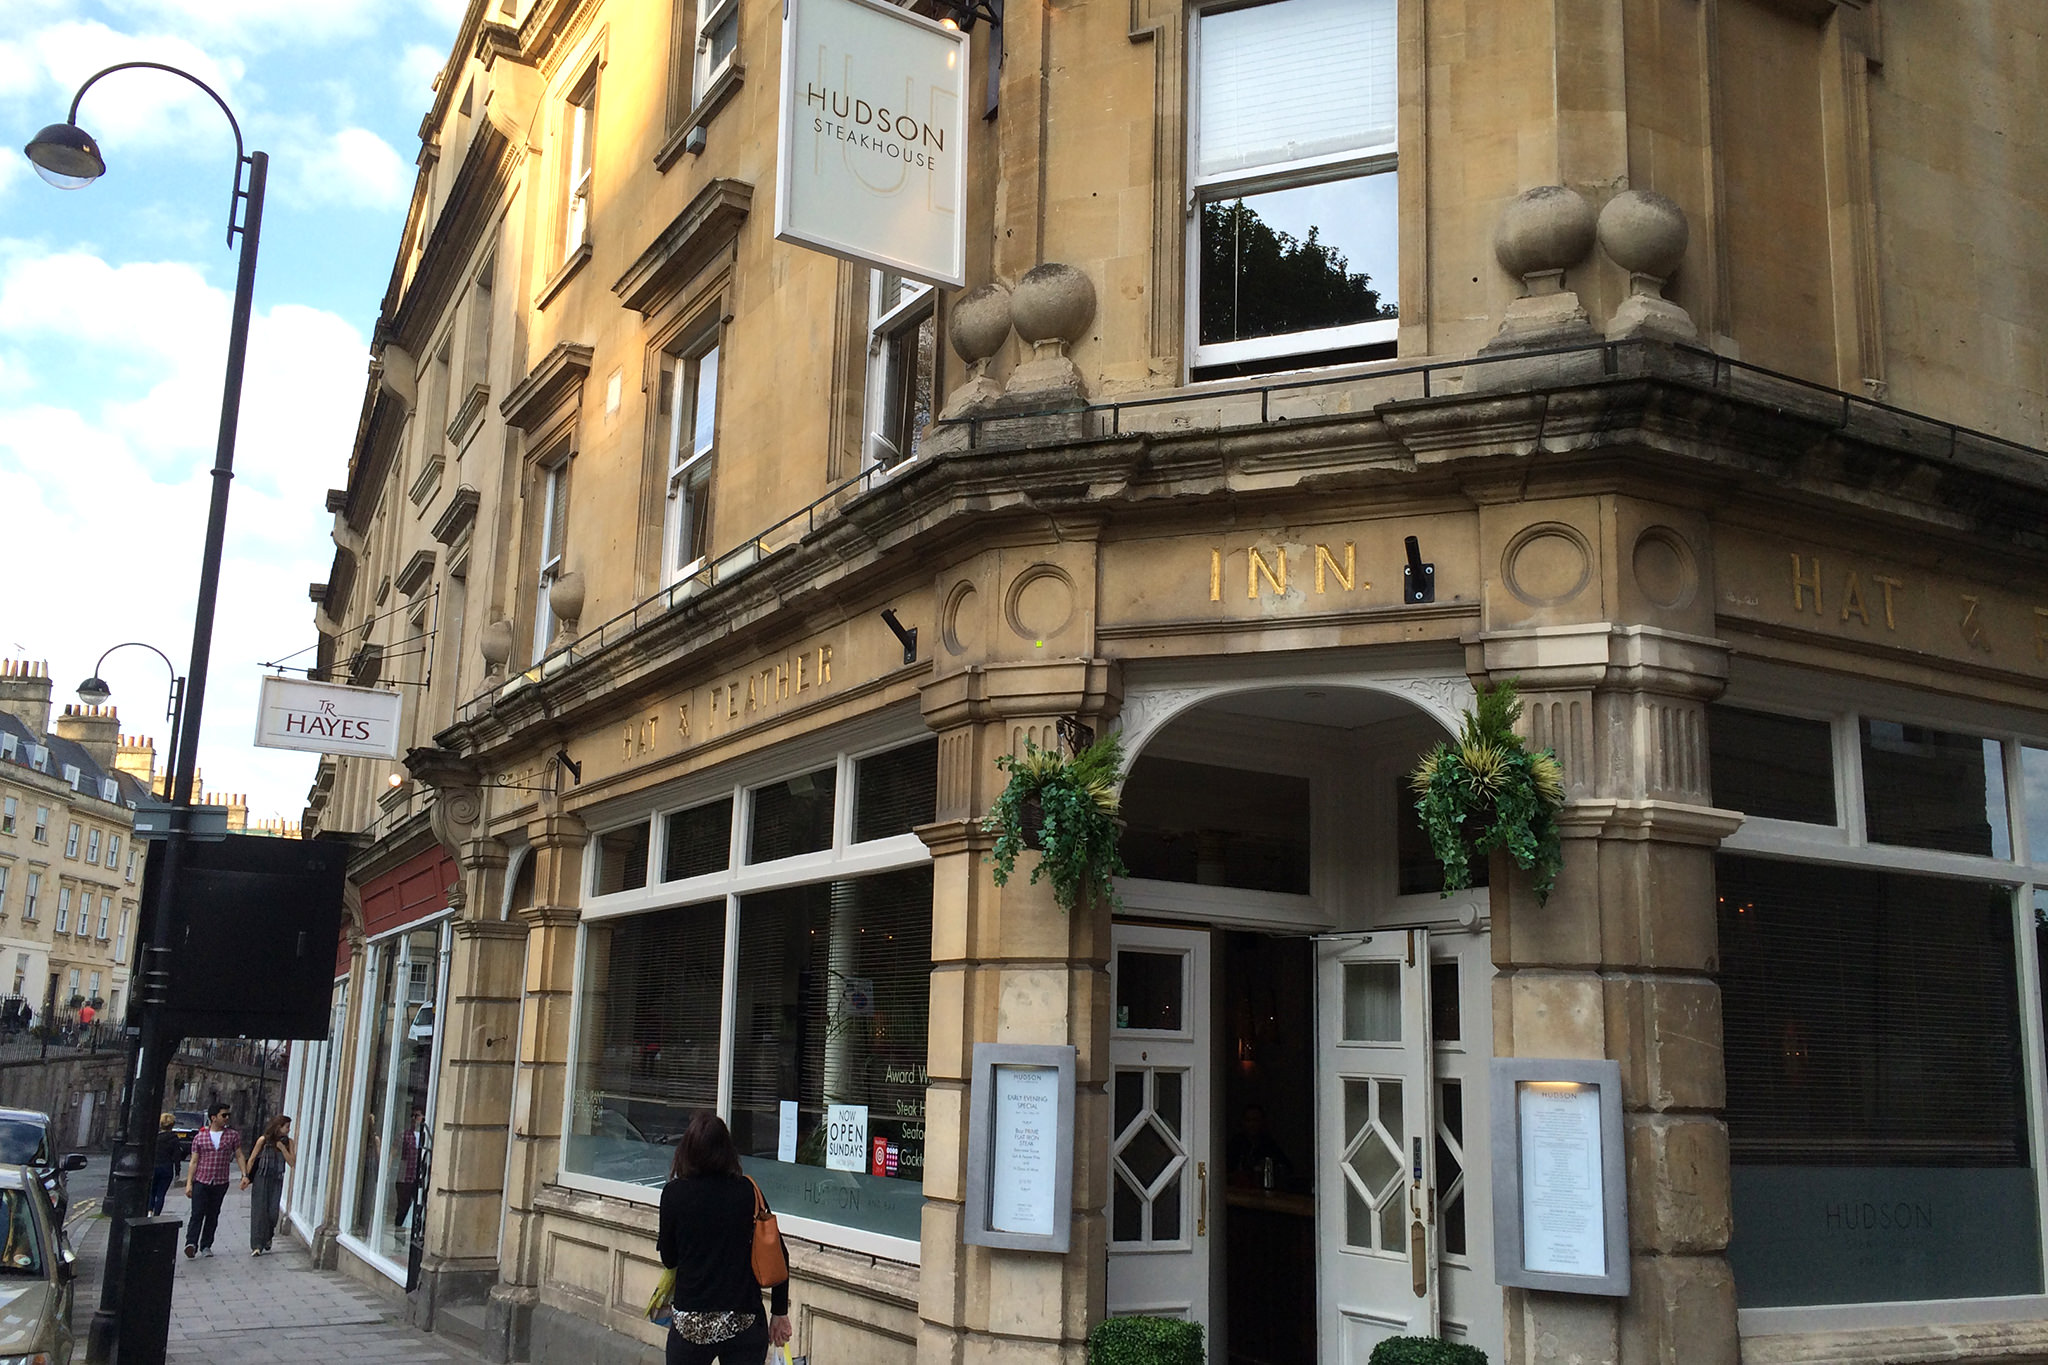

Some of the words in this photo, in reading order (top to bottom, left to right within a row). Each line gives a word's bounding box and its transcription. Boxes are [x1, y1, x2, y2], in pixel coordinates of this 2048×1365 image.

[807, 82, 943, 152] HUDSON
[813, 118, 935, 171] STEAKHOUSE
[1790, 552, 1903, 630] HAT
[319, 699, 337, 717] TR
[622, 716, 659, 762] HAT
[709, 644, 833, 729] FEATHER
[286, 713, 370, 740] HAYES
[885, 1063, 916, 1085] Award
[1017, 1102, 1038, 1110] SPECIAL
[1541, 1092, 1577, 1100] HUDSON
[839, 1109, 857, 1122] NOW
[896, 1098, 918, 1117] Steak
[830, 1122, 864, 1142] OPEN
[829, 1142, 864, 1159] SUNDAYS
[1825, 1202, 1933, 1231] HUDSON
